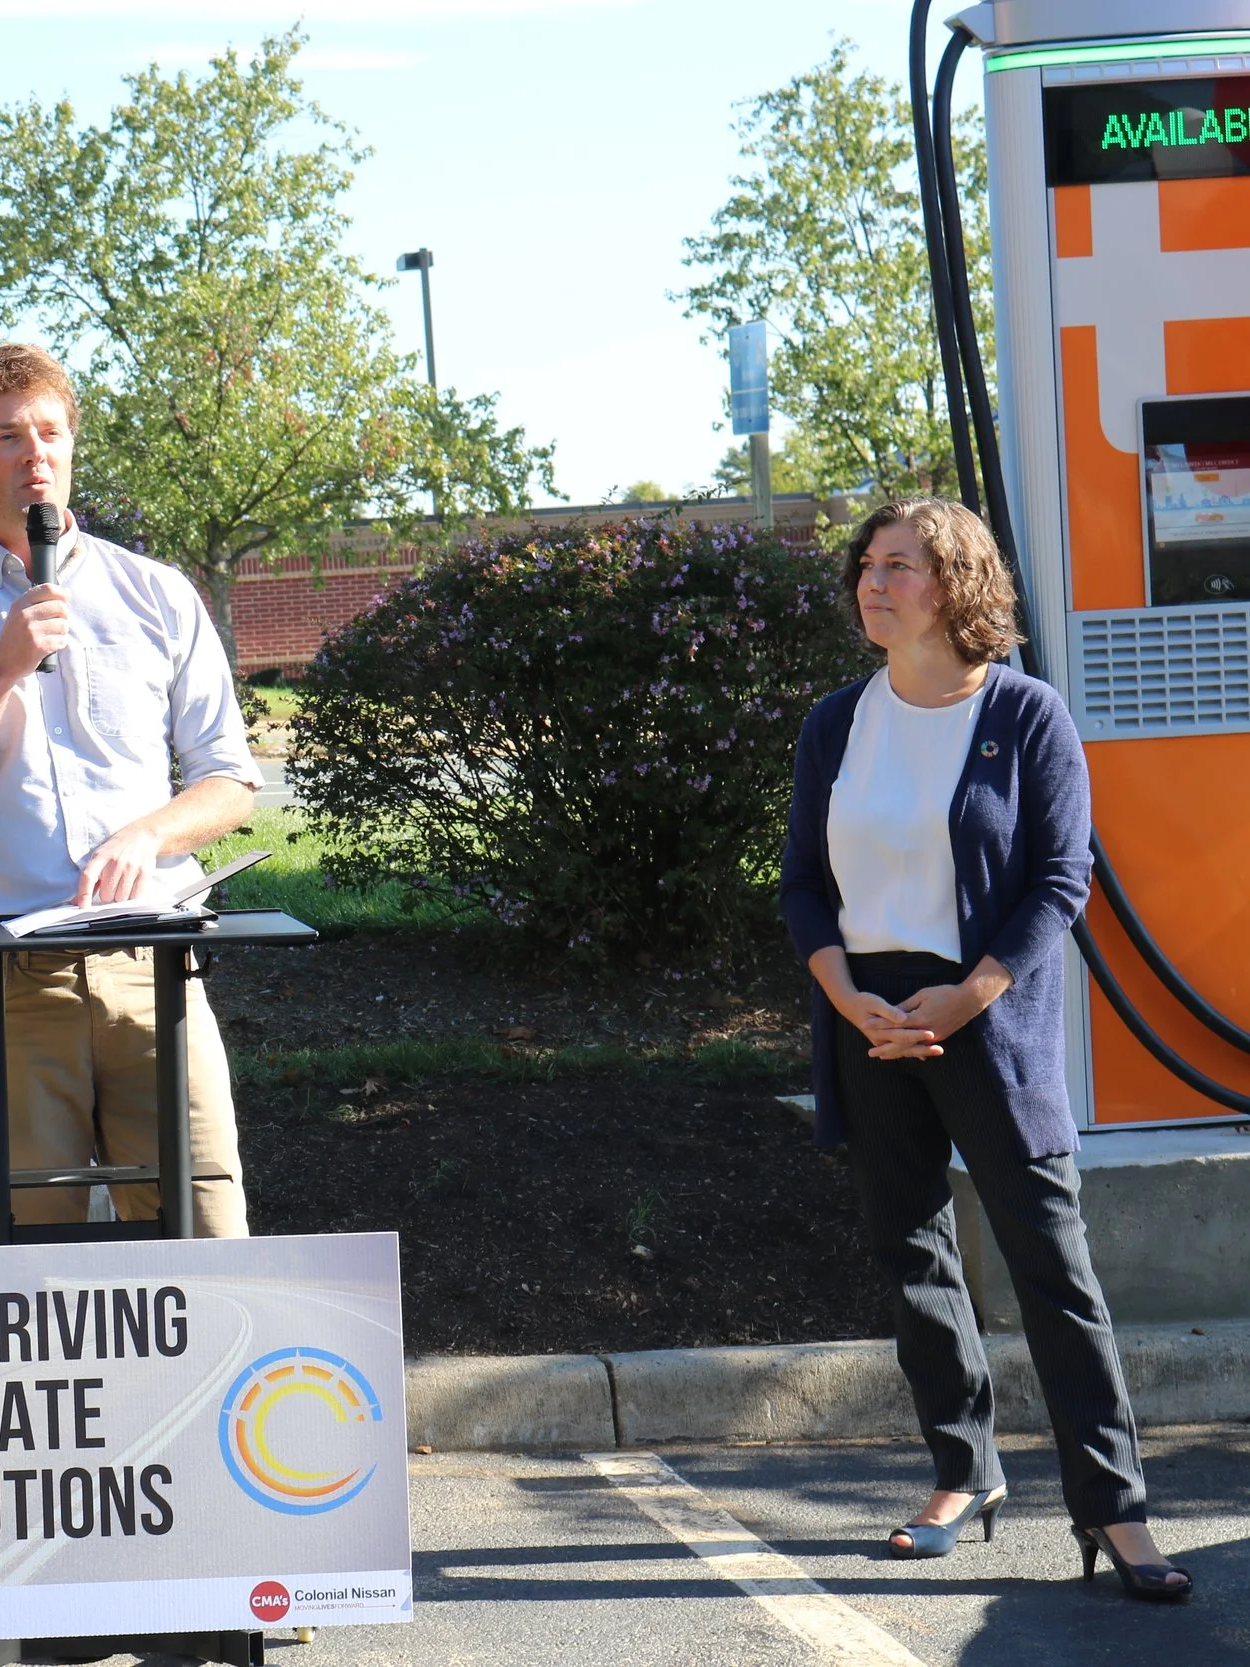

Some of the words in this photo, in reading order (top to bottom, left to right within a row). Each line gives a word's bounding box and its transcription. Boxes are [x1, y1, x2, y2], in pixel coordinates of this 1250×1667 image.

[1102, 107, 1250, 149] AVAILAB
[252, 1595, 288, 1608] CMA's
[294, 1588, 348, 1602] Colonial
[351, 1587, 396, 1599] Nissan
